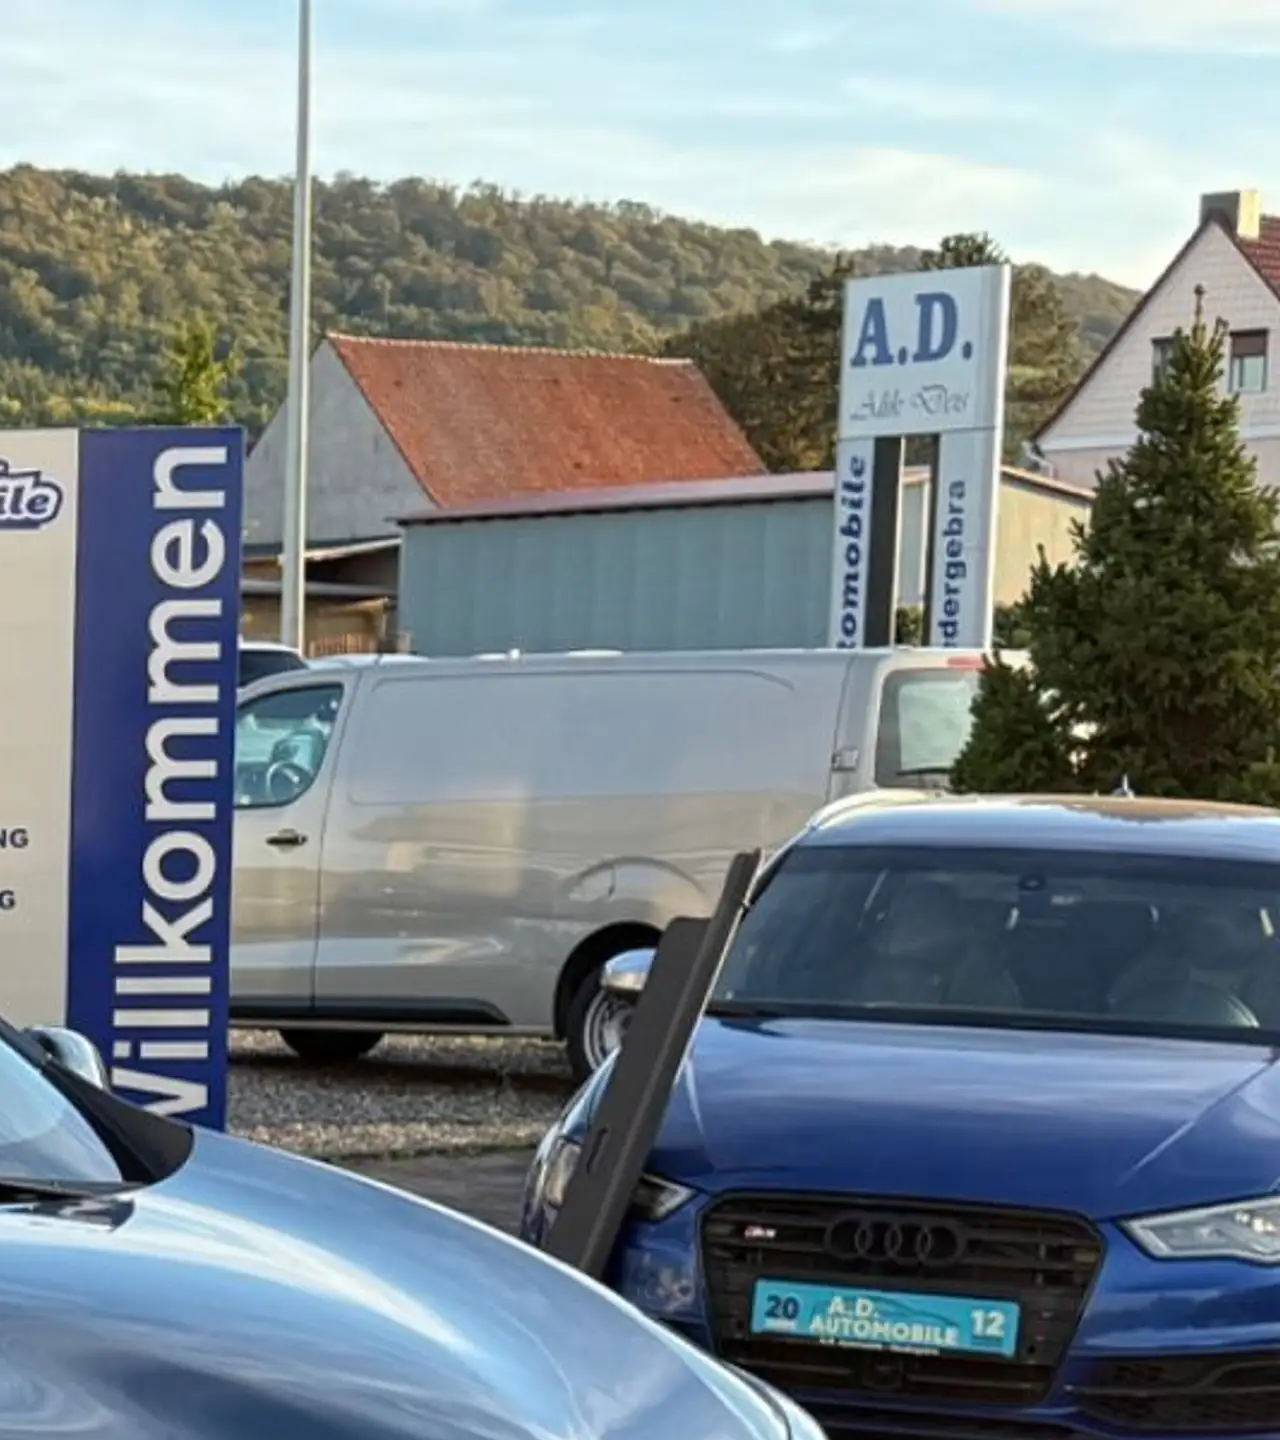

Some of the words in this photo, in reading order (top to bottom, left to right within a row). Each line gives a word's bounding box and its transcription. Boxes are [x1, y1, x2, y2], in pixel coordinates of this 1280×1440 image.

[850, 291, 973, 368] A.D.
[837, 456, 866, 650] tomobile
[764, 1294, 800, 1319] 20
[971, 1309, 1006, 1336] 12
[809, 1315, 960, 1346] AUTOMOBILE
